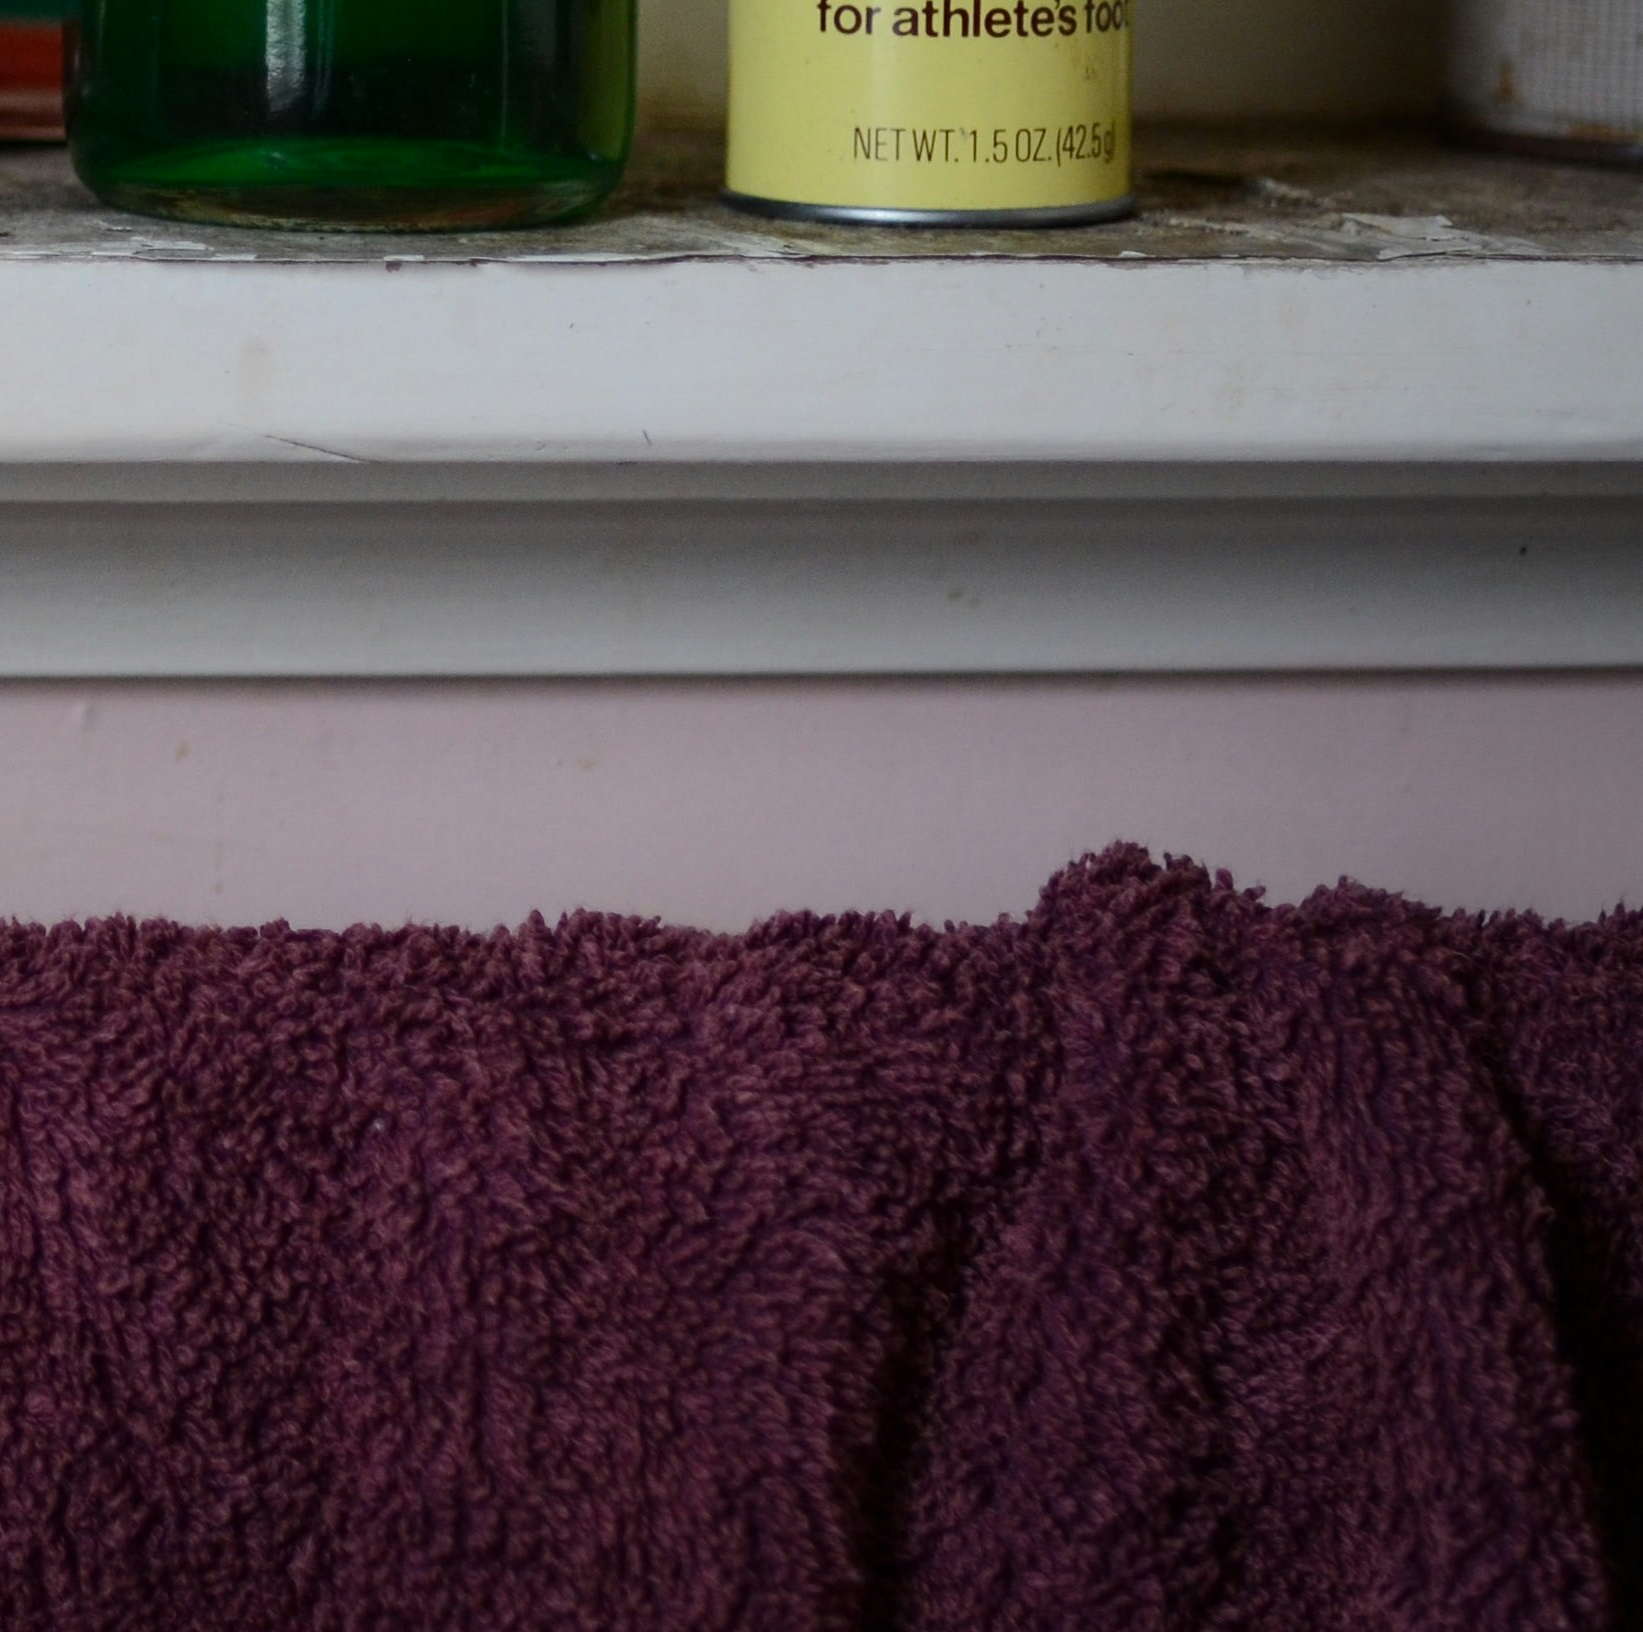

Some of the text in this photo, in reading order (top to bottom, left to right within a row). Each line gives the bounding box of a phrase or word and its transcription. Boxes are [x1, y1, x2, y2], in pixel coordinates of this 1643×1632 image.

[853, 127, 907, 162] NET
[912, 129, 959, 163] WT.
[970, 129, 1008, 164] 1.5
[1015, 128, 1053, 163] OZ.
